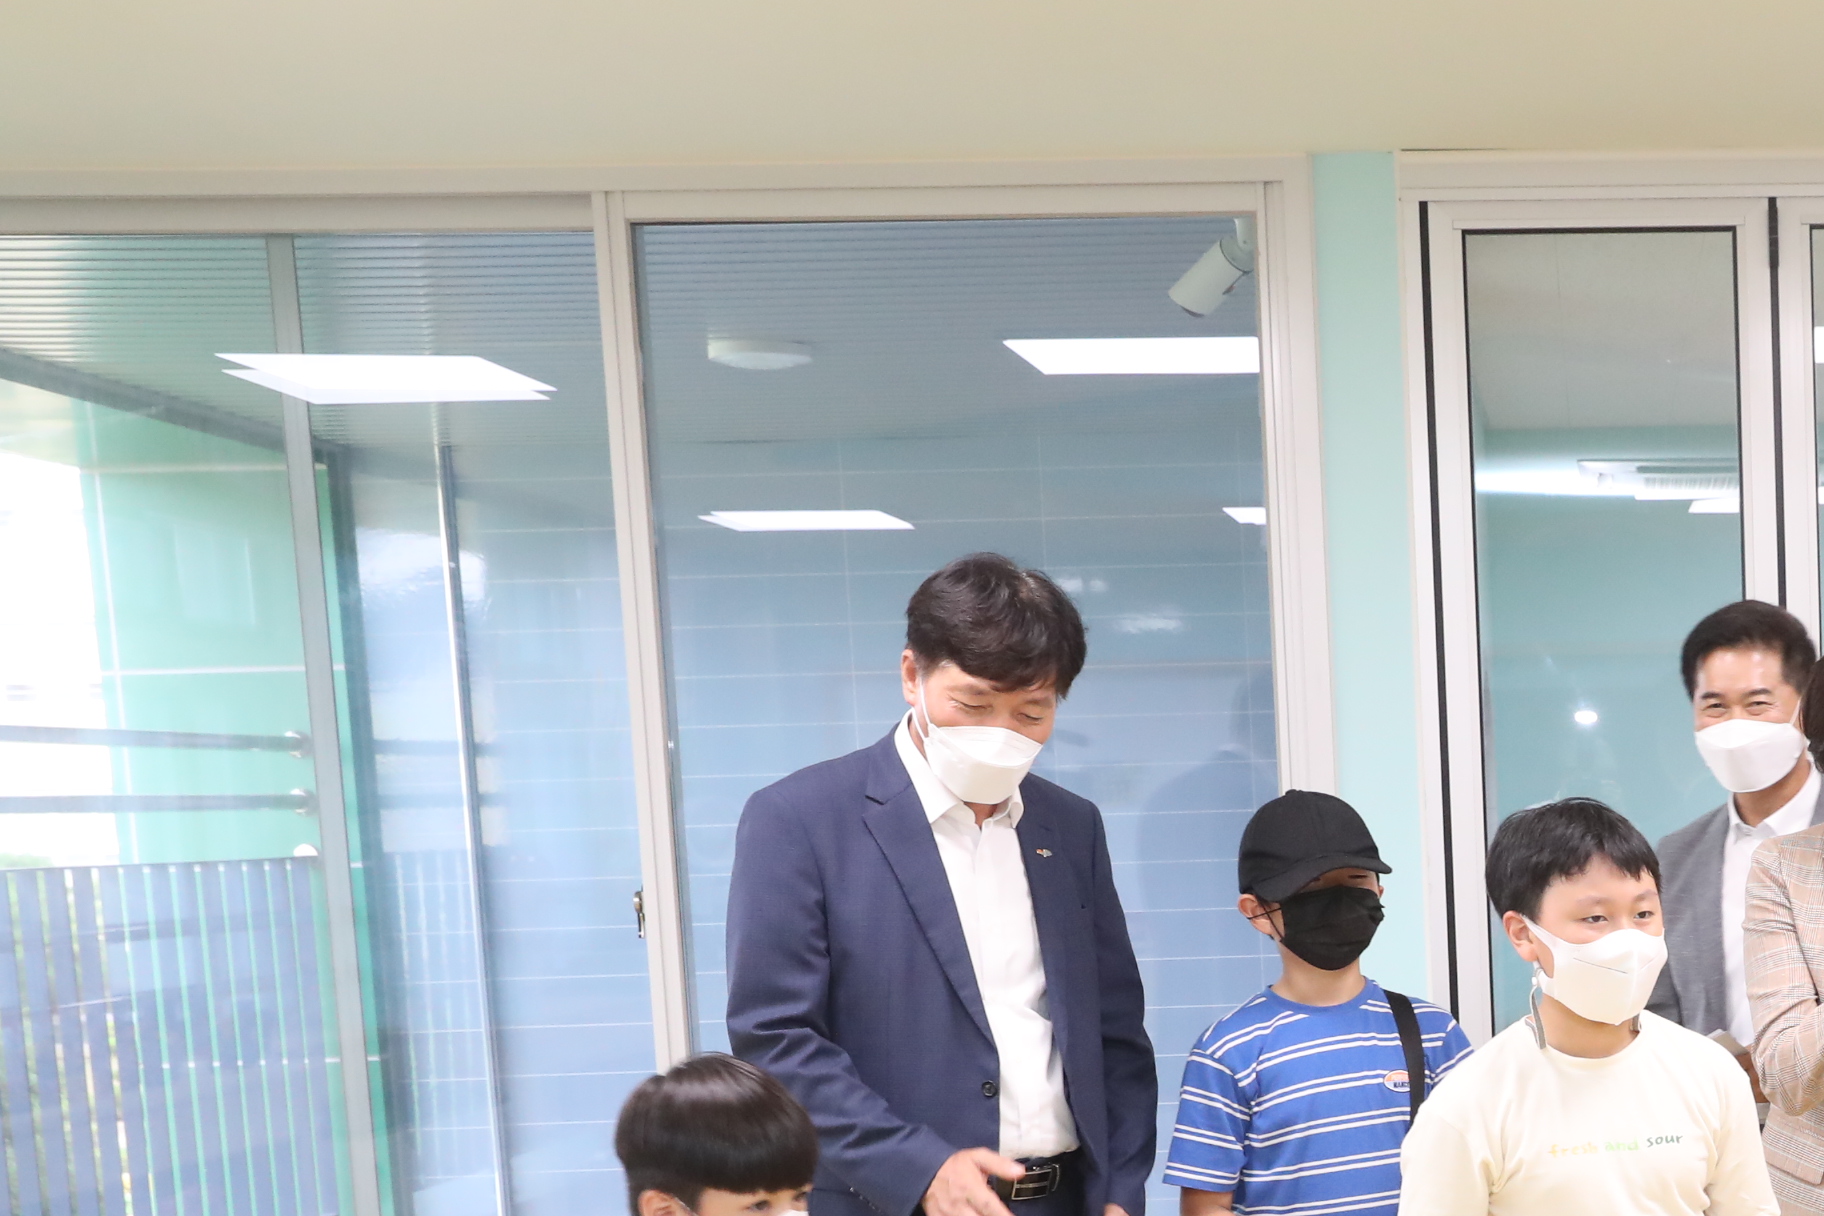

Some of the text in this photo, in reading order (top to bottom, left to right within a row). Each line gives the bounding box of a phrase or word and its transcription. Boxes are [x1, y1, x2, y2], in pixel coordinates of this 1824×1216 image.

[1548, 1134, 1683, 1158] fresh and sour
